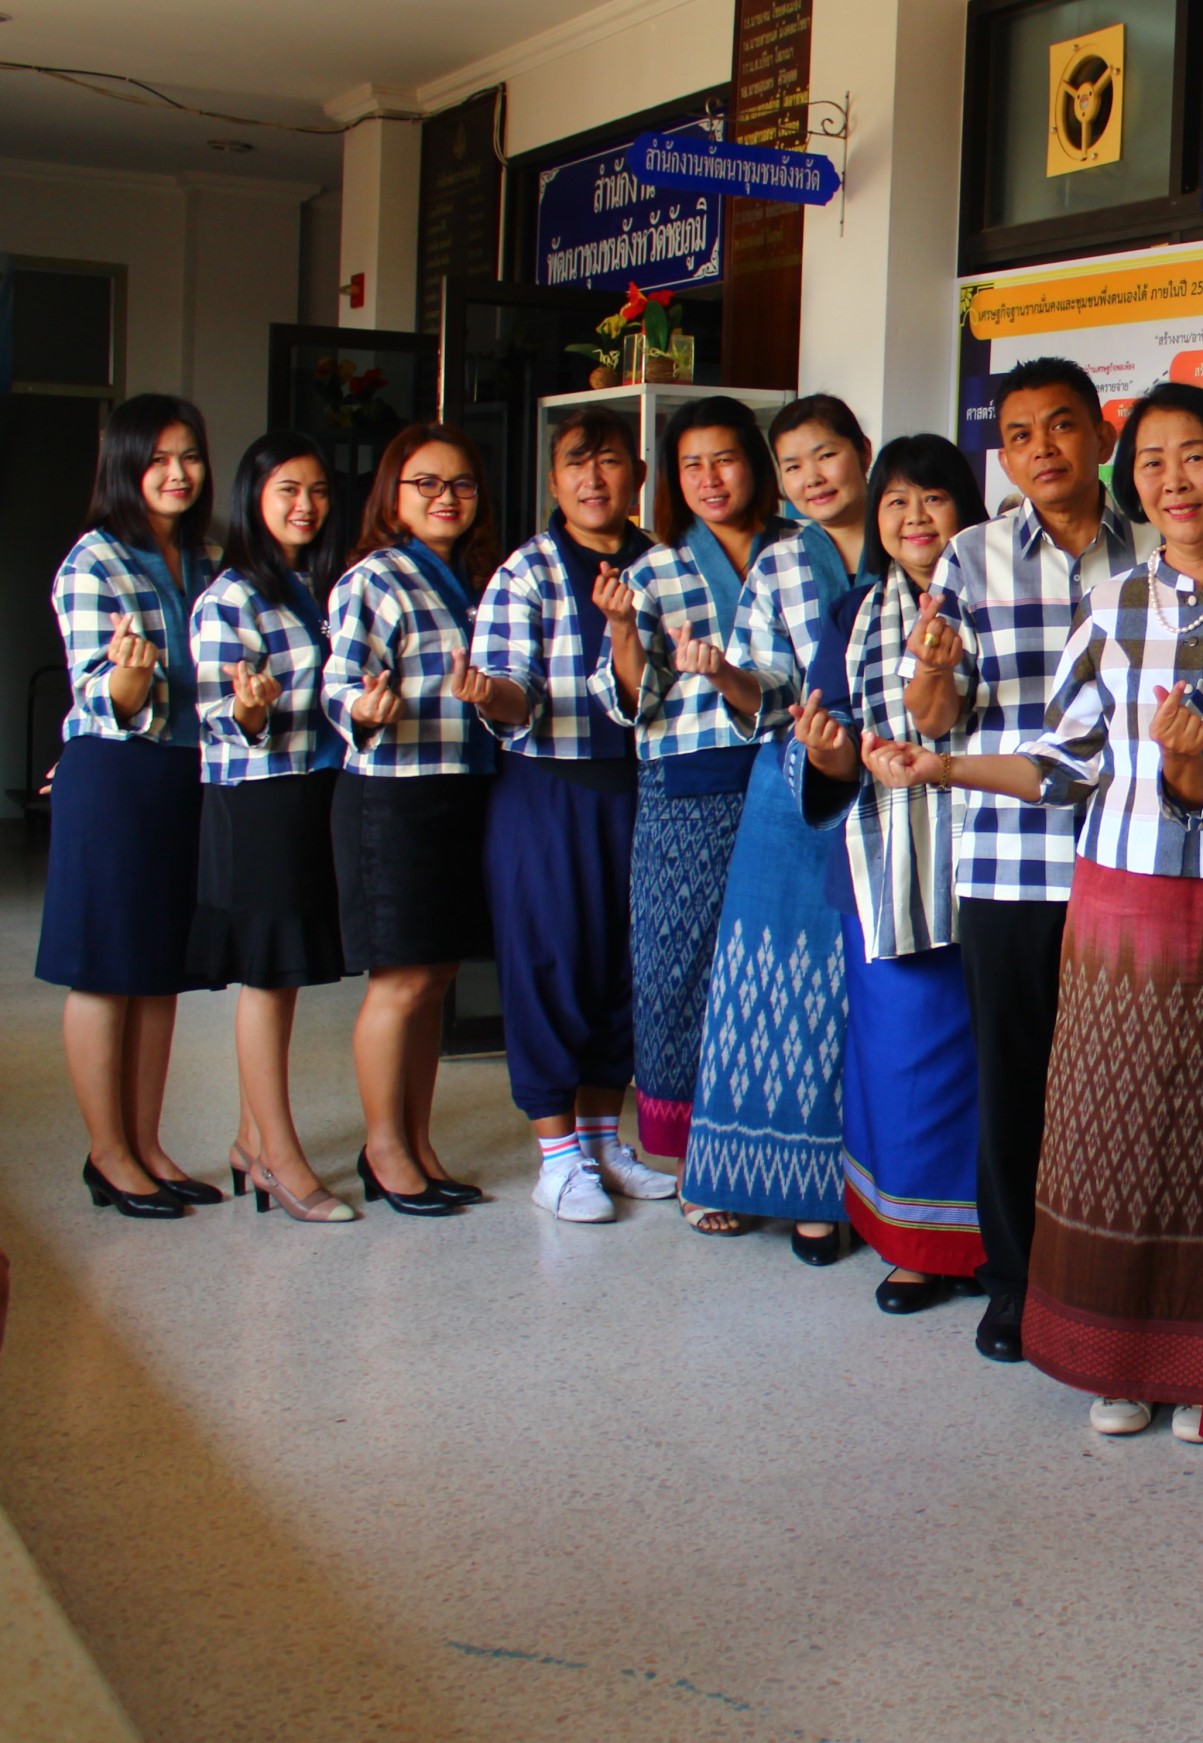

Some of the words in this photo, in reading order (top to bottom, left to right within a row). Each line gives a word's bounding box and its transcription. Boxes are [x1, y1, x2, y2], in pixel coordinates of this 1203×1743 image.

[645, 138, 820, 195] สำนักงานพัฒนาชุมชนจังหวัด
[547, 197, 707, 290] พัฒนาชุมชนจังหวัดชัยภูมิ
[1150, 279, 1187, 301] ภายในปี
